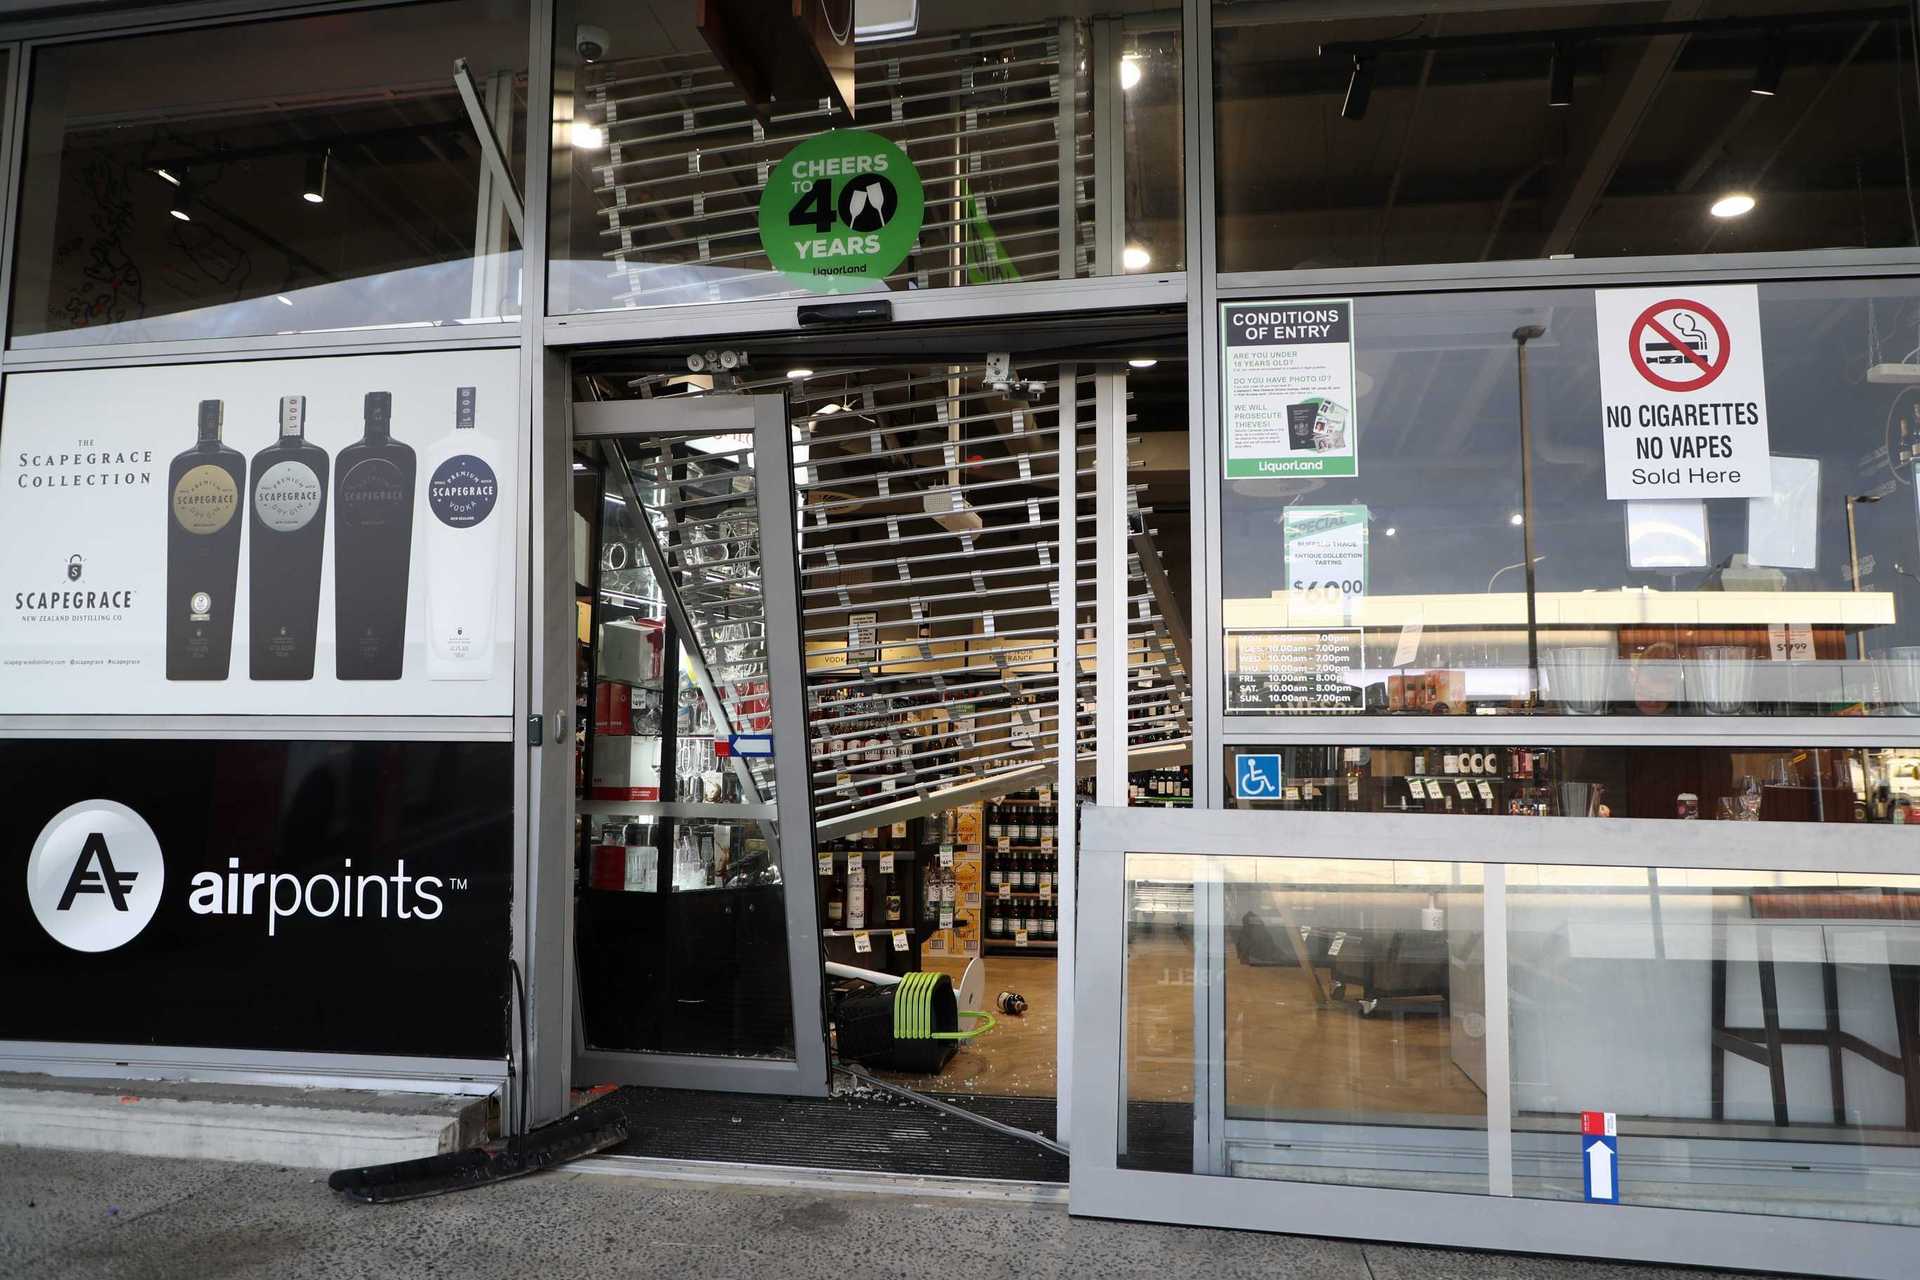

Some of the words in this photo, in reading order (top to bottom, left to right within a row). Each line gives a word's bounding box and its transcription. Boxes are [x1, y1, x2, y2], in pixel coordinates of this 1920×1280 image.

[792, 154, 889, 178] CHEERS
[791, 180, 814, 193] TO
[788, 173, 898, 233] 40
[794, 235, 881, 260] YEARS
[813, 264, 867, 276] LiquorLand
[1232, 310, 1339, 326] CONDITIONS
[1245, 327, 1270, 341] OF
[1274, 325, 1331, 339] ENTRY
[1233, 352, 1249, 360] ARE
[1270, 351, 1298, 359] UNDER
[1233, 377, 1246, 385] DO
[1248, 377, 1264, 385] YOU
[1266, 376, 1288, 384] HAVE
[1234, 404, 1247, 412] WE
[1234, 412, 1282, 420] PROSECUTE
[1606, 405, 1632, 428] NO
[1638, 402, 1759, 428] CIGARETTES
[78, 439, 95, 447] THE
[1636, 436, 1663, 460] NO
[1669, 435, 1733, 459] VAPES
[19, 451, 153, 468] SCAPEGRACE
[1258, 460, 1324, 473] LiquorLand
[18, 471, 152, 489] COLLECTION
[447, 471, 480, 484] PREMIUM
[1632, 468, 1680, 485] Sold
[1689, 467, 1741, 484] Here
[259, 491, 317, 502] SCAPEGRACE
[432, 486, 494, 497] SCAPEGRACE
[177, 494, 233, 505] SCAPEGRACE
[15, 590, 133, 610] SCAPEGRACE
[39, 614, 70, 622] ZEALAND
[72, 614, 111, 622] DISTILLING
[1315, 645, 1350, 653] 7.00pm
[824, 656, 848, 664] VODK
[1315, 654, 1350, 663] 7.00pm
[1315, 665, 1351, 673] 7.00pm
[1315, 685, 1352, 693] 8.00pm
[1315, 695, 1351, 704] 7.00pm
[188, 857, 444, 936] airpoints
